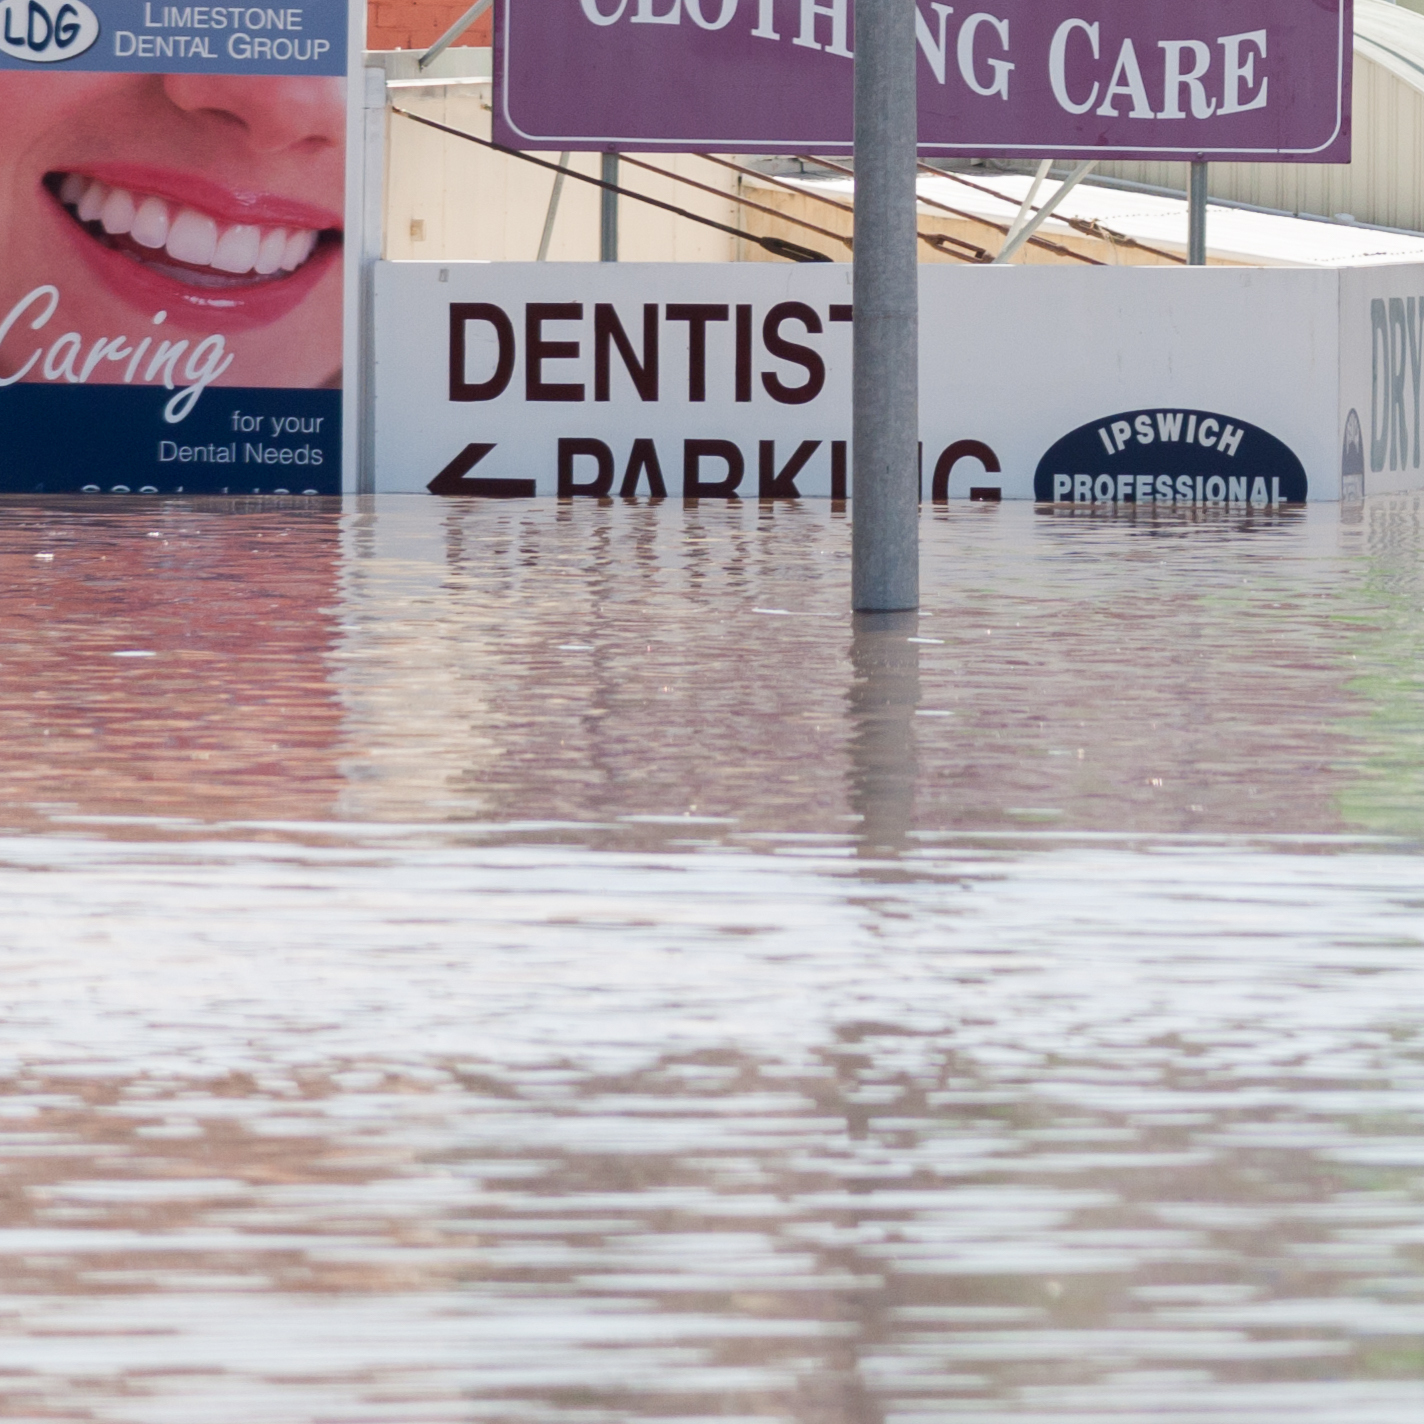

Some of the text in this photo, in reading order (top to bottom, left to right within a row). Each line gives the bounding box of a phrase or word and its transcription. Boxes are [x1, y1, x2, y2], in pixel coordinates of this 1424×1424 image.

[3, 0, 82, 52] LDG
[144, 1, 304, 30] LIMESTONE
[114, 31, 331, 61] DENTAL GROUP
[1048, 17, 1270, 120] CARE
[0, 284, 235, 424] Caring
[231, 410, 325, 438] for your
[1097, 411, 1245, 456] IPSWICH
[158, 440, 324, 465] Dental Needs
[557, 437, 1003, 501] PARKIG
[1053, 473, 1288, 504] PROFESSIONAL
